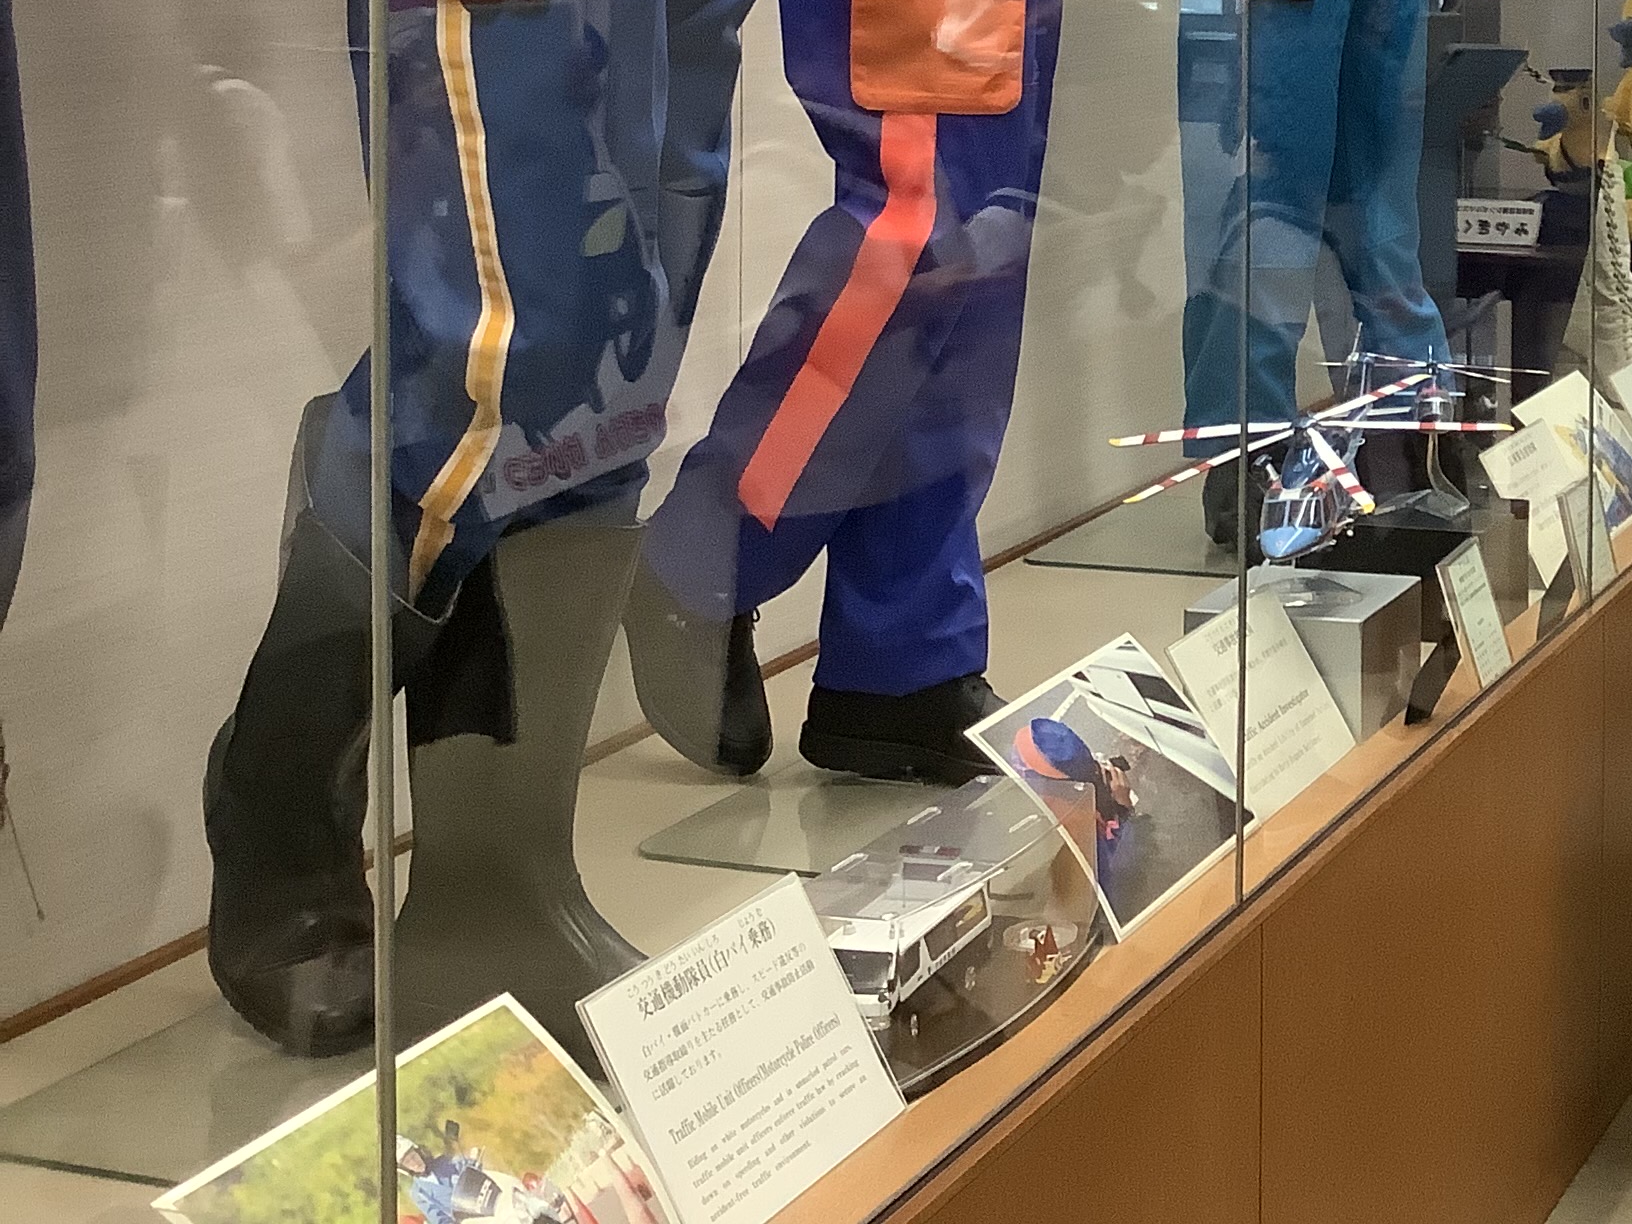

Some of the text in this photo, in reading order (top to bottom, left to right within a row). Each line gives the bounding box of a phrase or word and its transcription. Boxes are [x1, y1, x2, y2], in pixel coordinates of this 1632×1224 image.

[667, 1117, 696, 1144] Traffic
[692, 1100, 719, 1127] Mobile
[715, 1089, 736, 1110] Unit
[792, 1033, 815, 1055] Police
